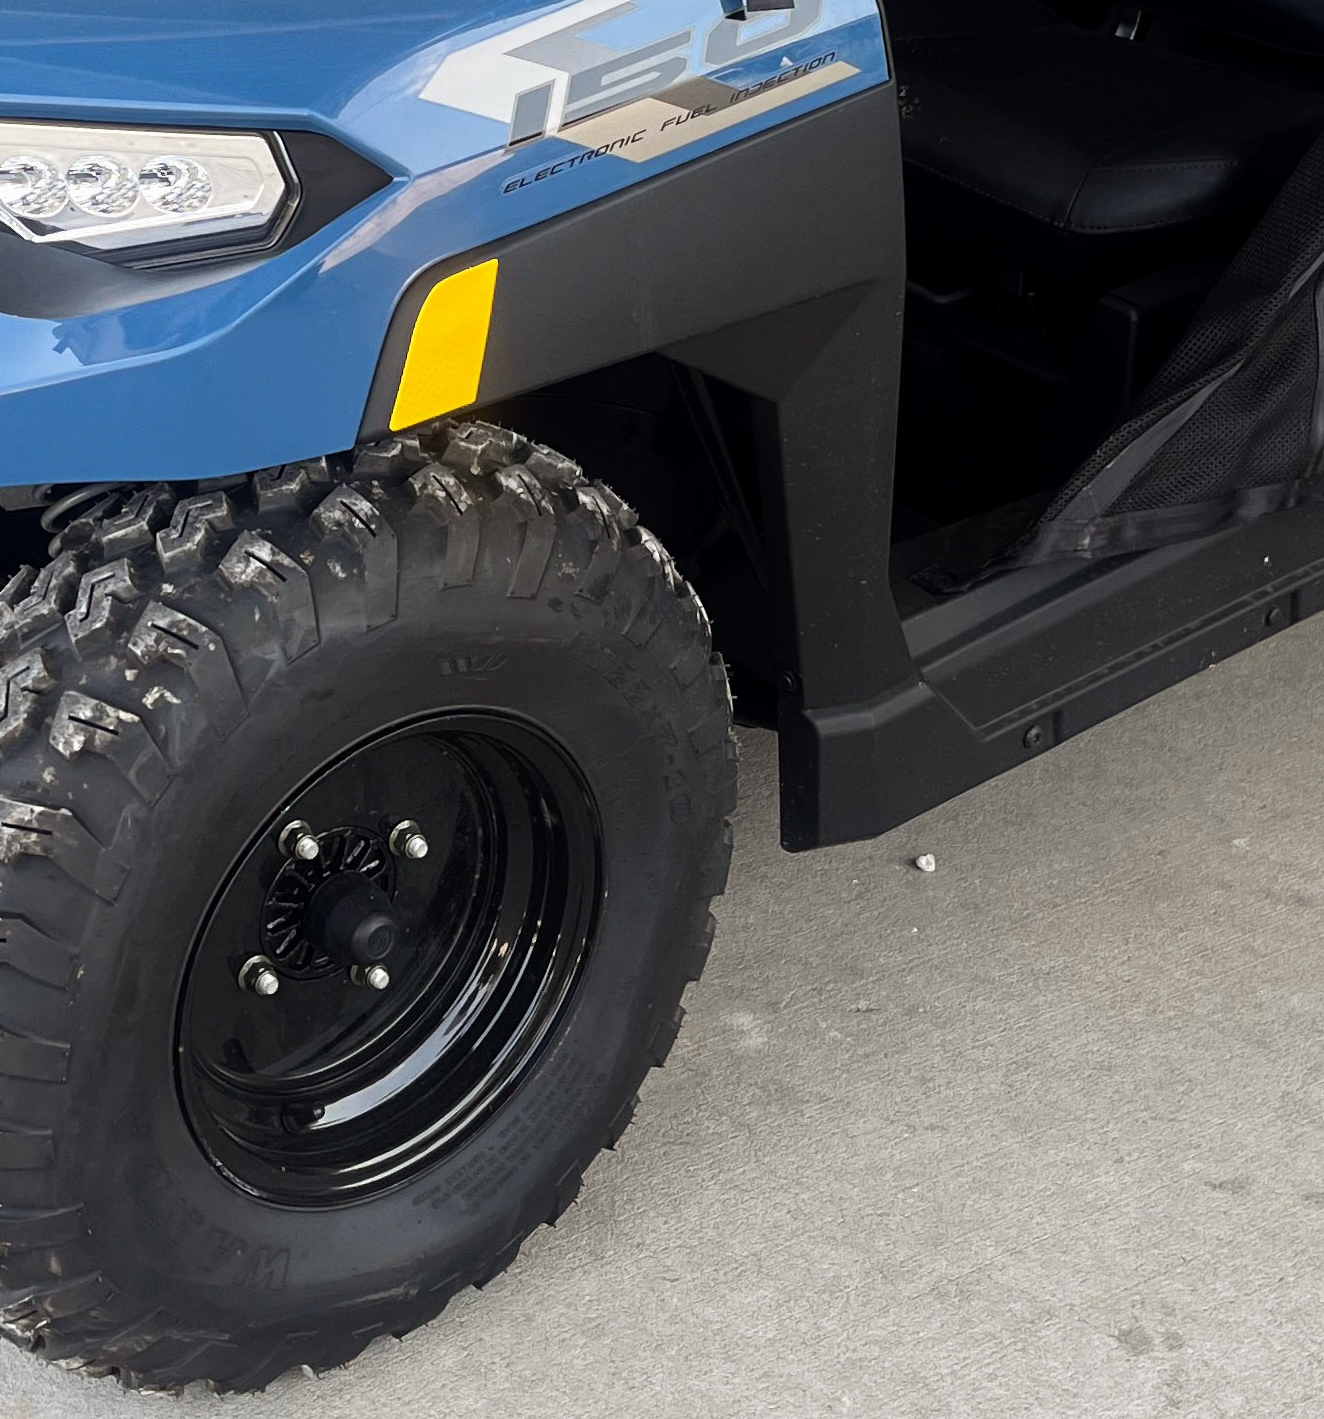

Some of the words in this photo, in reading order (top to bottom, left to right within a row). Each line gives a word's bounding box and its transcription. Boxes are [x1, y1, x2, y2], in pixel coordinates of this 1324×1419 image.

[502, 129, 648, 194] ELECTRONIC
[660, 104, 717, 132] FUEL
[730, 51, 836, 103] INJECTION
